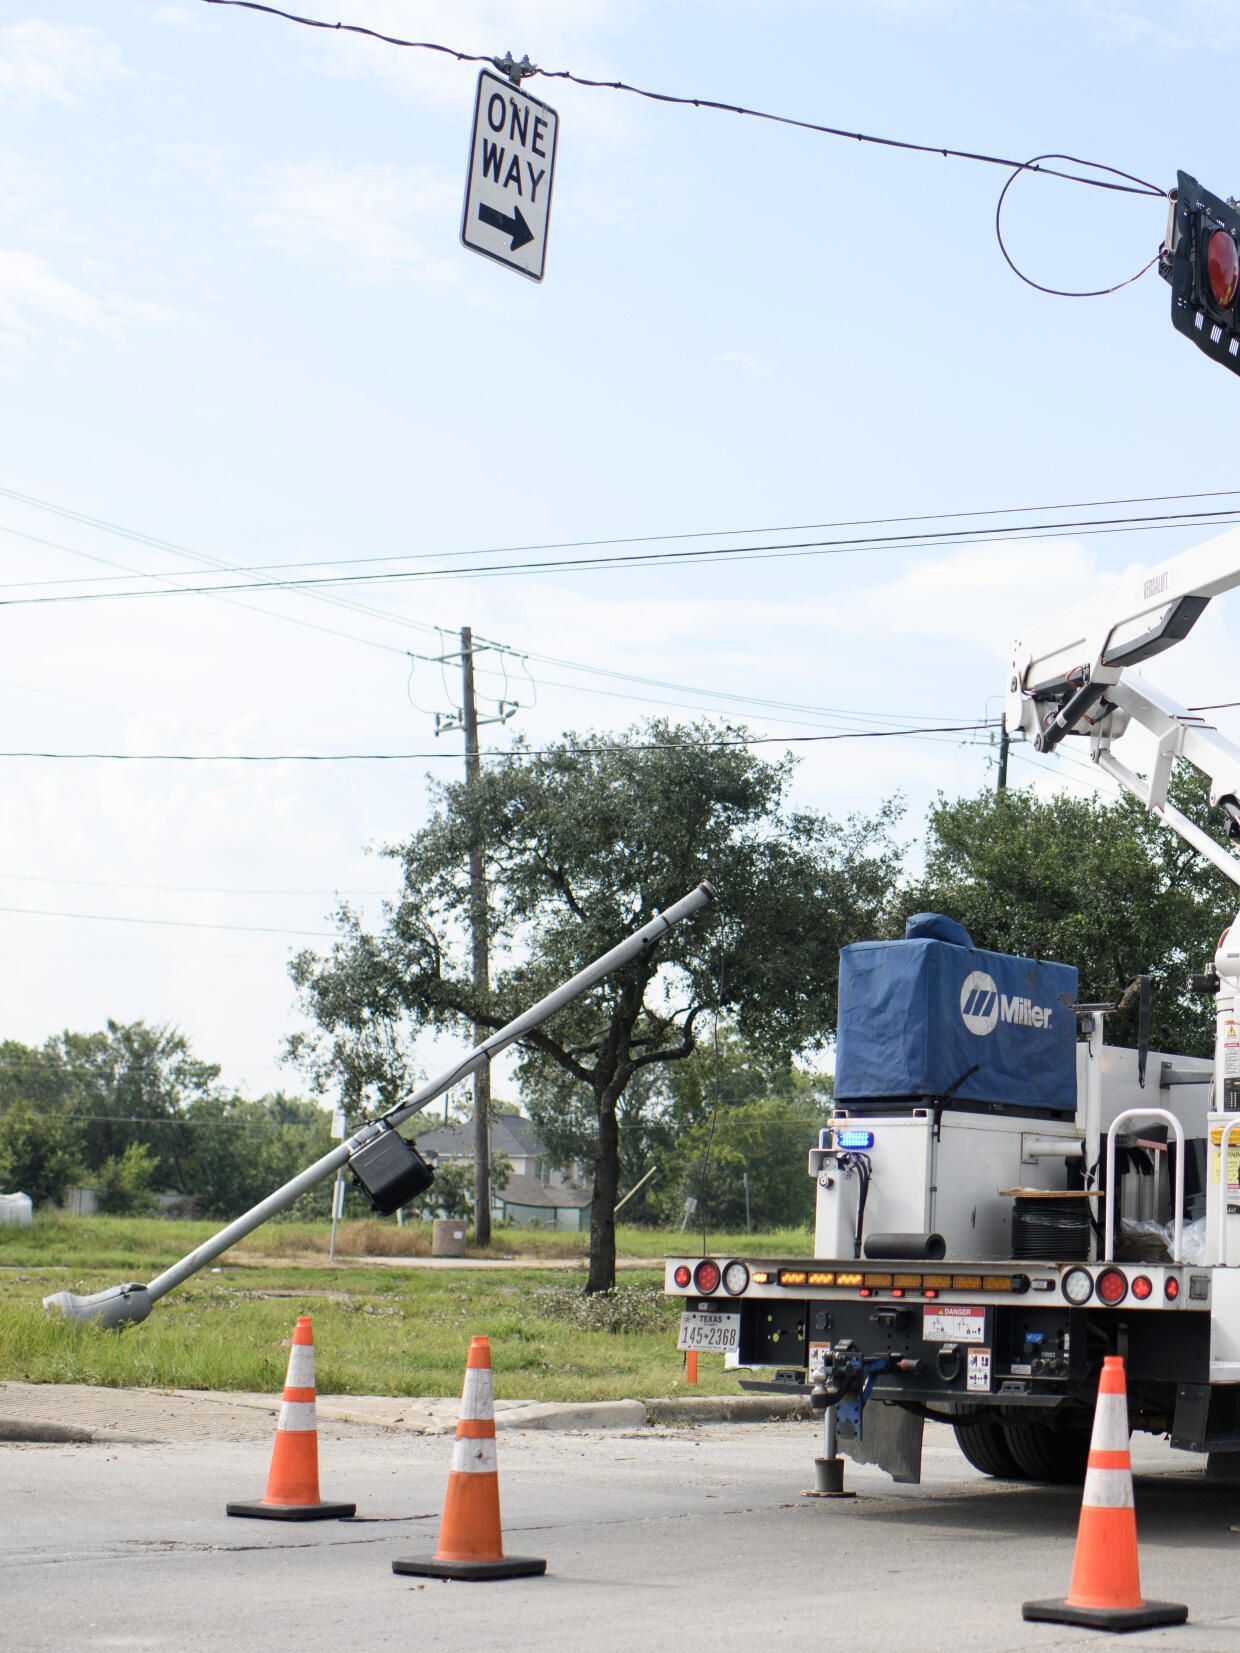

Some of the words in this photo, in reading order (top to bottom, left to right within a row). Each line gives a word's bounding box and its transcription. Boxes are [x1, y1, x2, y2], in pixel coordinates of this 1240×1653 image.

[487, 92, 548, 159] ONE
[482, 137, 546, 204] WAY
[1000, 993, 1053, 1030] Miller
[699, 1314, 723, 1324] TEXAS
[944, 1308, 971, 1316] DANGER
